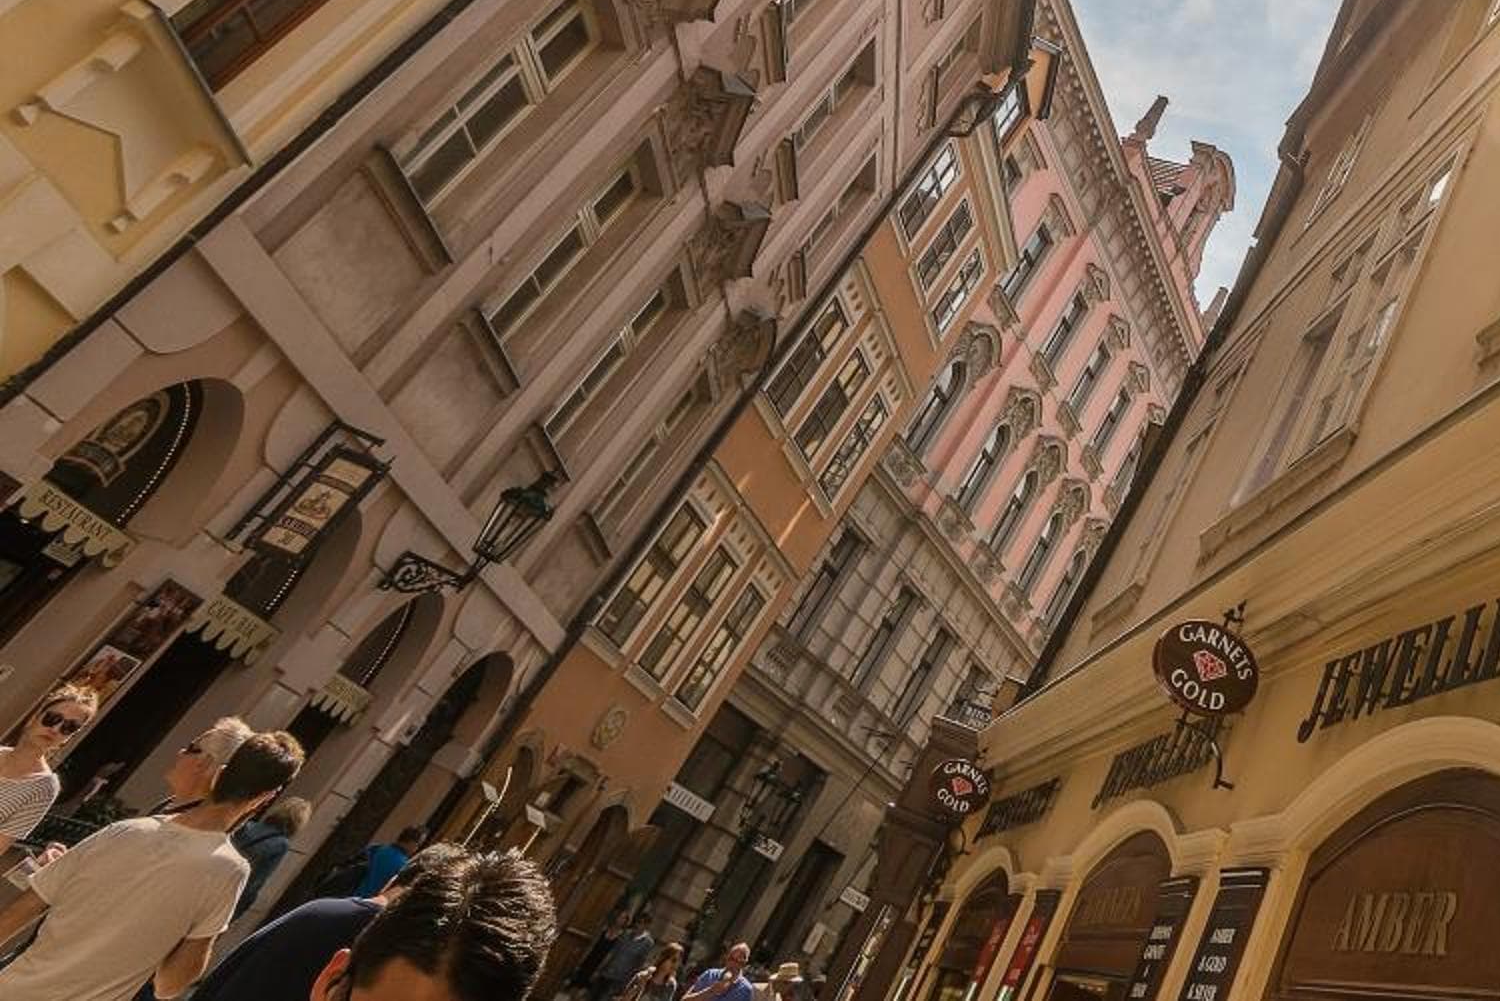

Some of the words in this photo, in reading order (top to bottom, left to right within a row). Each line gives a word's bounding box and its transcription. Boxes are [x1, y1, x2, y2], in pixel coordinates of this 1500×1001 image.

[1179, 625, 1253, 680] GARNETS
[1171, 668, 1225, 710] GOLD
[943, 762, 989, 795] GARNETS
[937, 788, 970, 812] GOLD
[1331, 892, 1457, 956] AMBER
